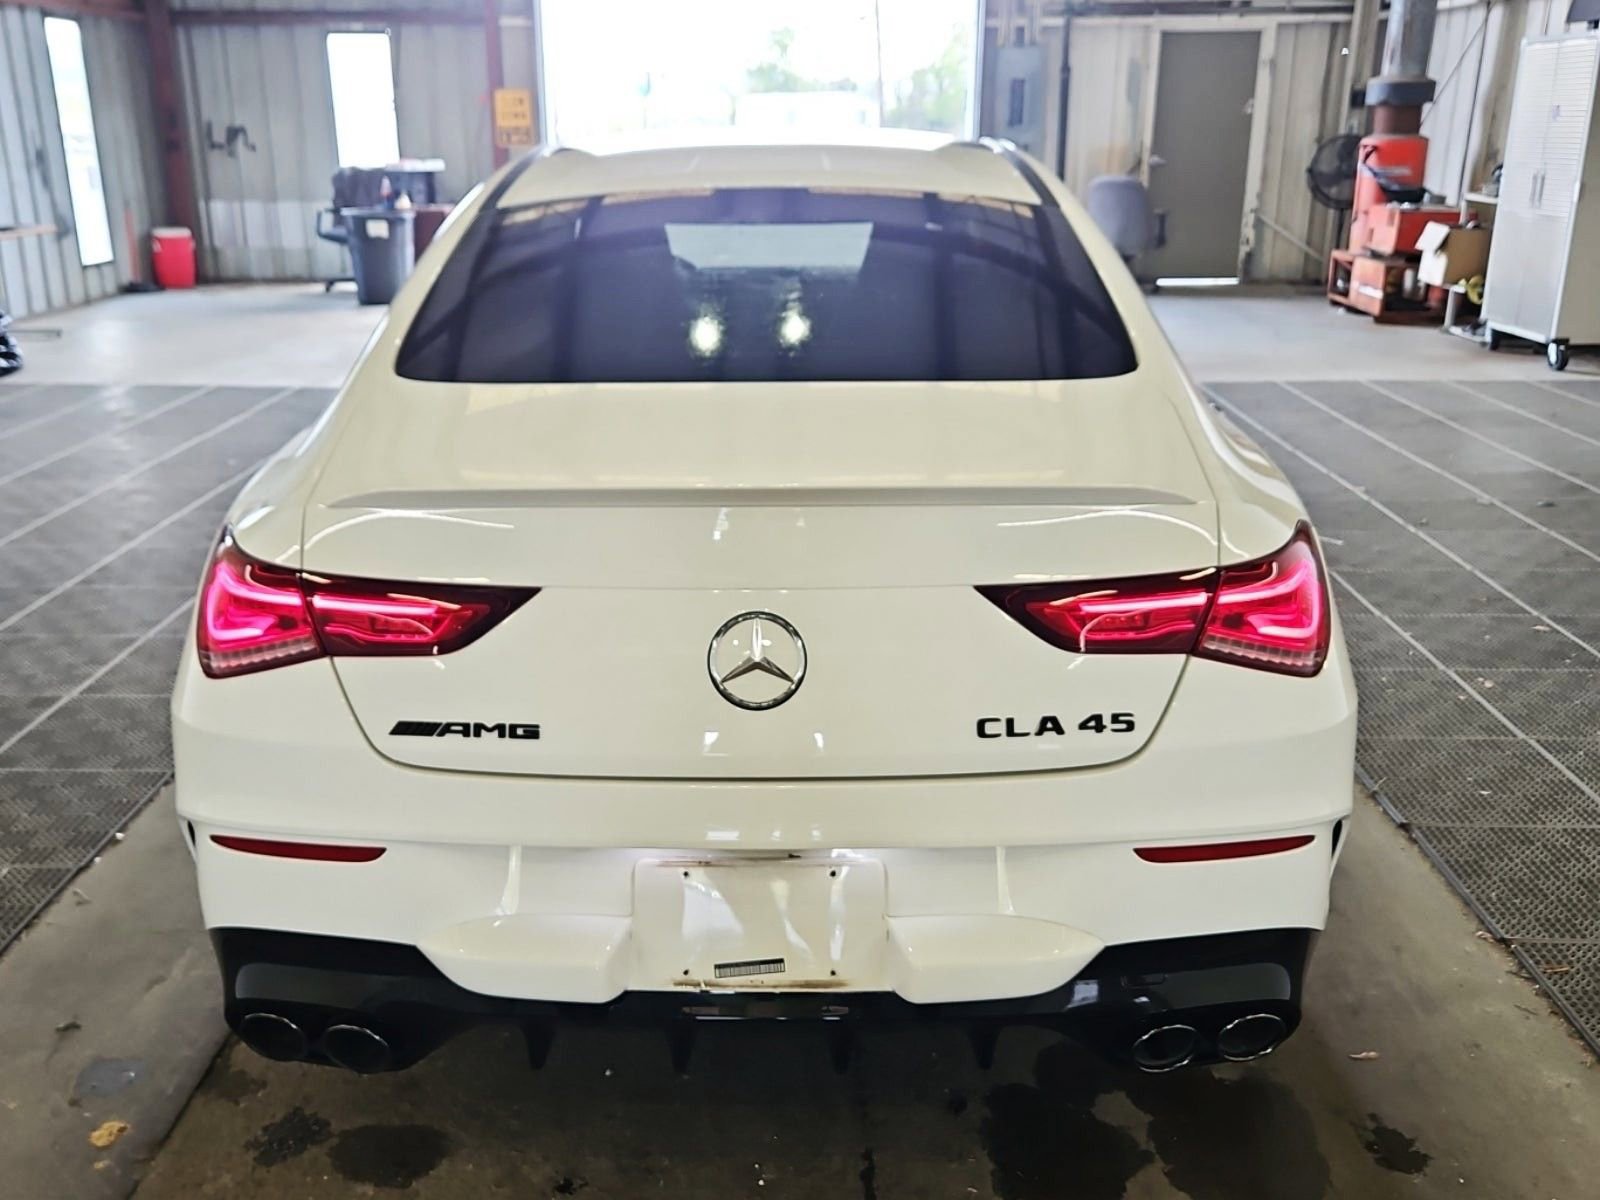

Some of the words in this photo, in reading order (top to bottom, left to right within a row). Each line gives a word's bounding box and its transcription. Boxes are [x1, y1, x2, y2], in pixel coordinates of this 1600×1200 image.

[434, 721, 541, 740] AMG
[976, 715, 1066, 739] CLA
[1077, 712, 1136, 734] 45
